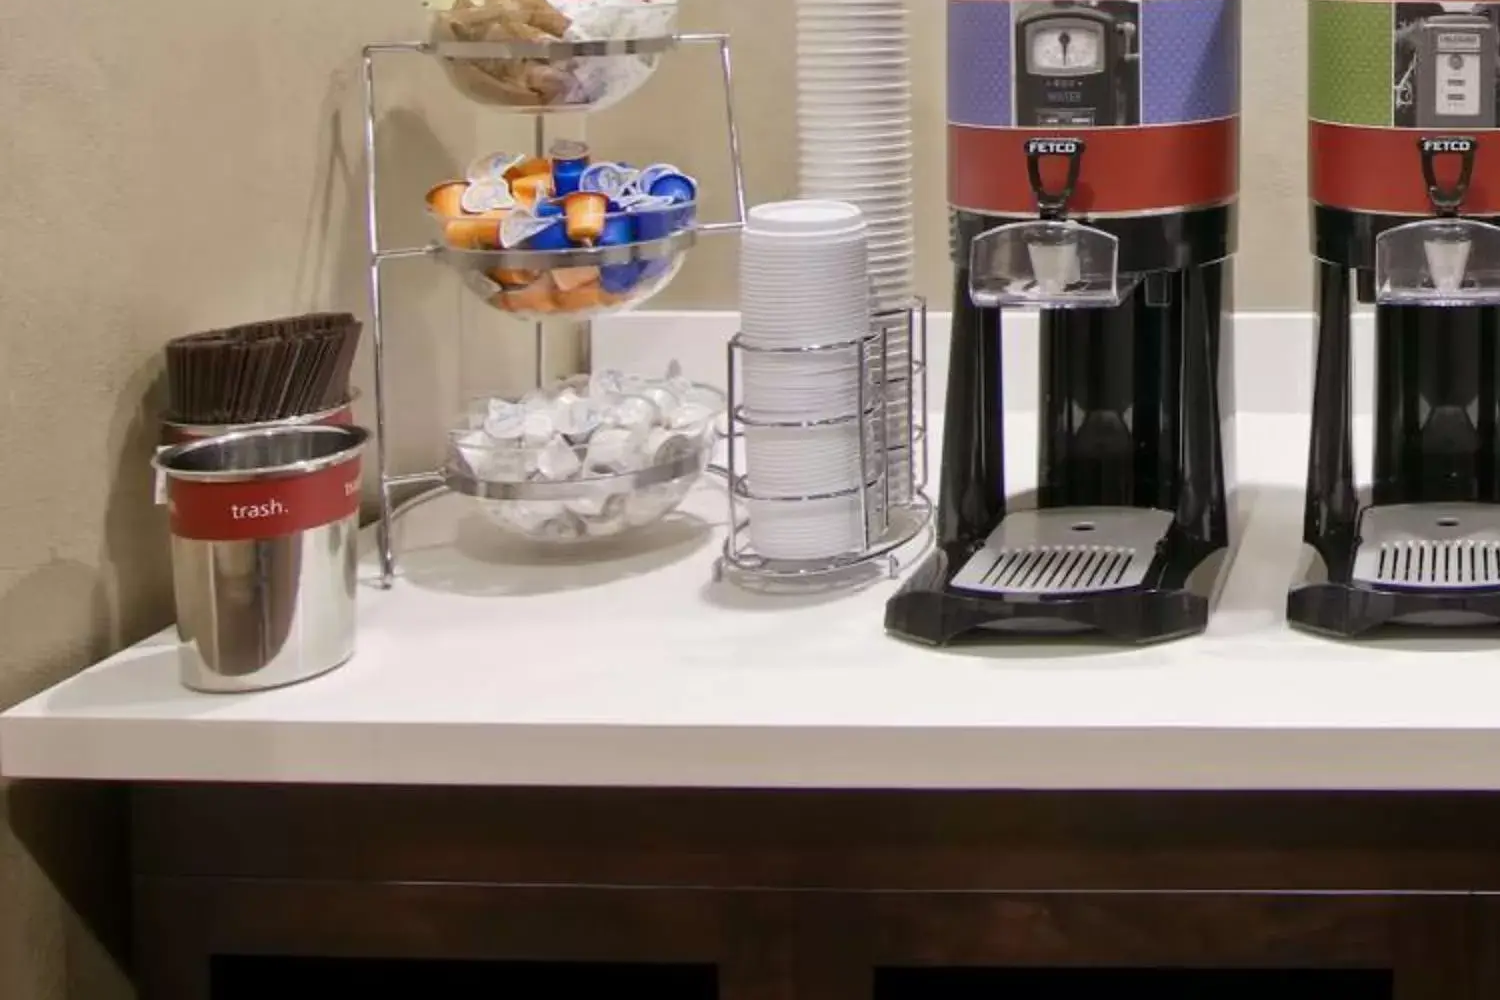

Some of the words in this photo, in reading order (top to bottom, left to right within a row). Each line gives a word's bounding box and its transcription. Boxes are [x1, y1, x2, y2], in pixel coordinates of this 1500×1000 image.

[1028, 141, 1077, 153] FETCO
[1423, 140, 1471, 152] FETCO
[231, 499, 290, 520] trash.
